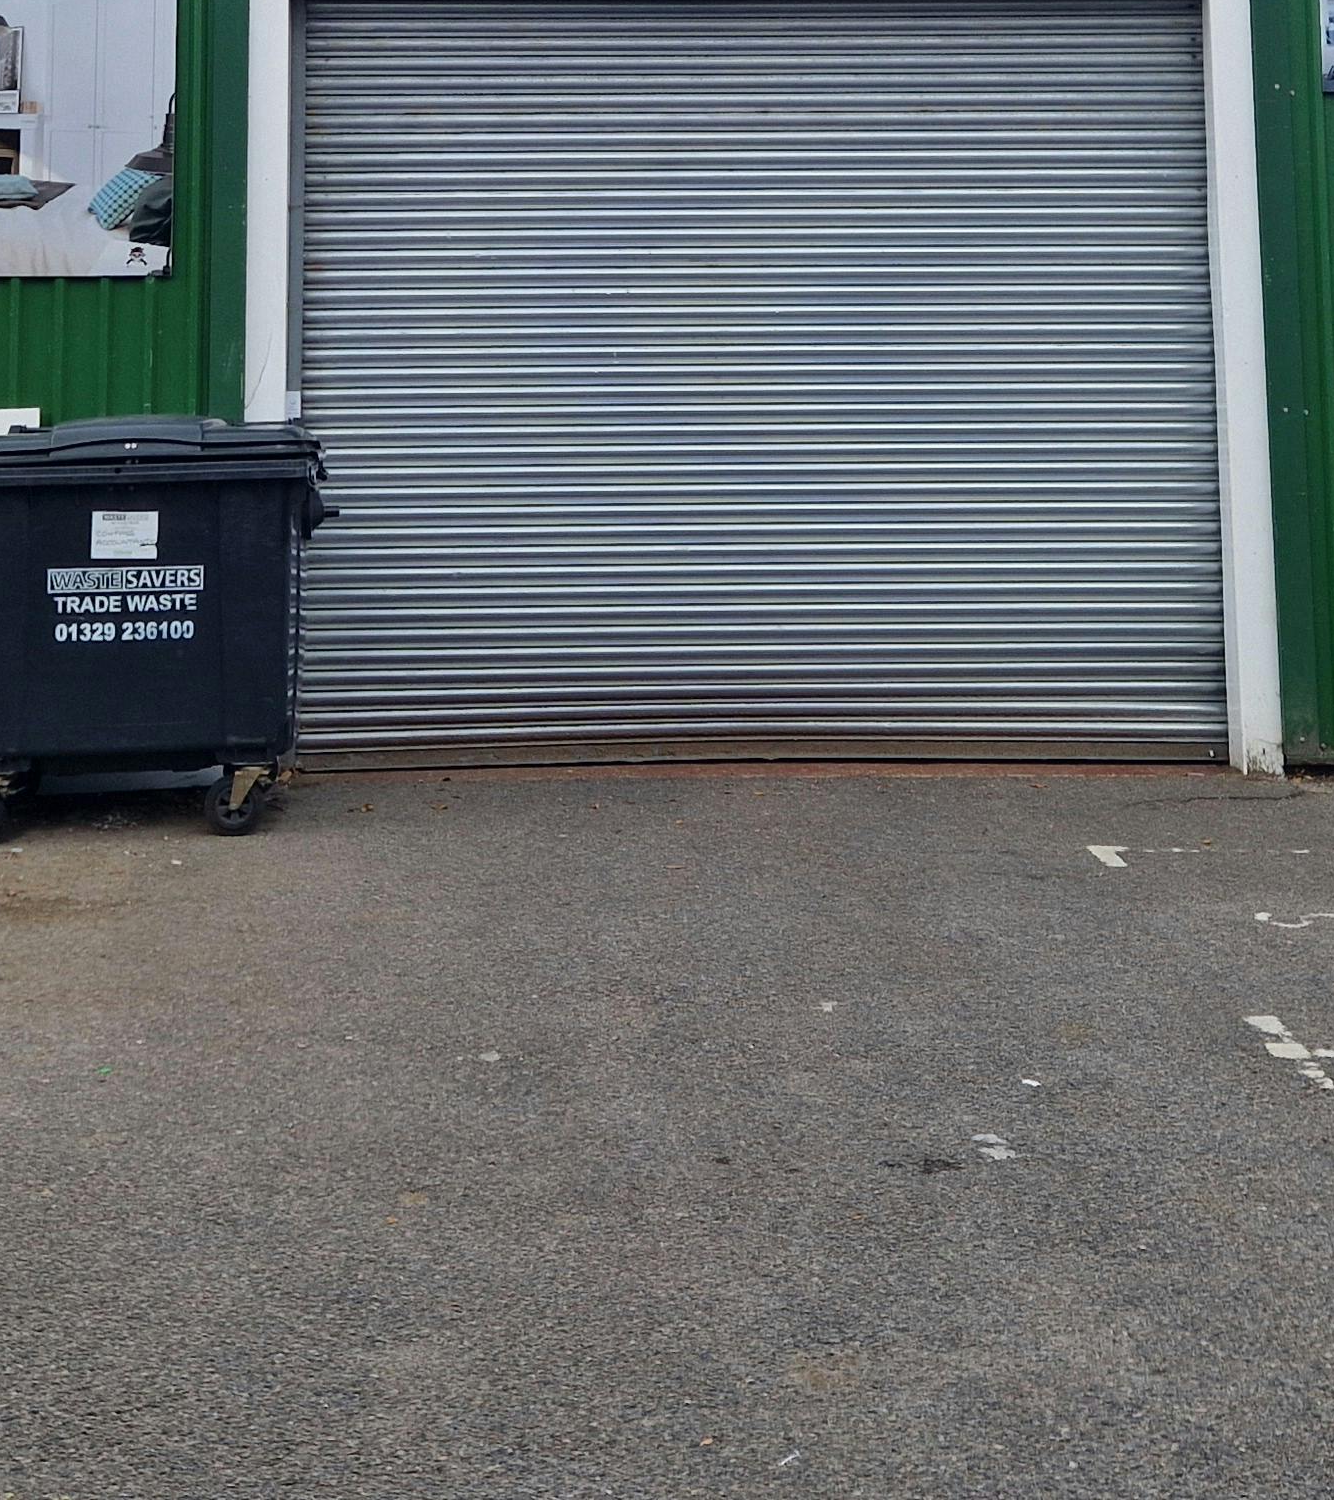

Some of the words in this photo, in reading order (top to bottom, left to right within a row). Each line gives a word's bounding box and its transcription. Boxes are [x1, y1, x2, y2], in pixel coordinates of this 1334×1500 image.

[51, 570, 122, 590] WASTE
[126, 569, 200, 588] SAVERS
[53, 595, 122, 613] TRADE
[126, 594, 197, 612] WASTE
[54, 622, 116, 642] 01329
[121, 620, 194, 641] 236100
